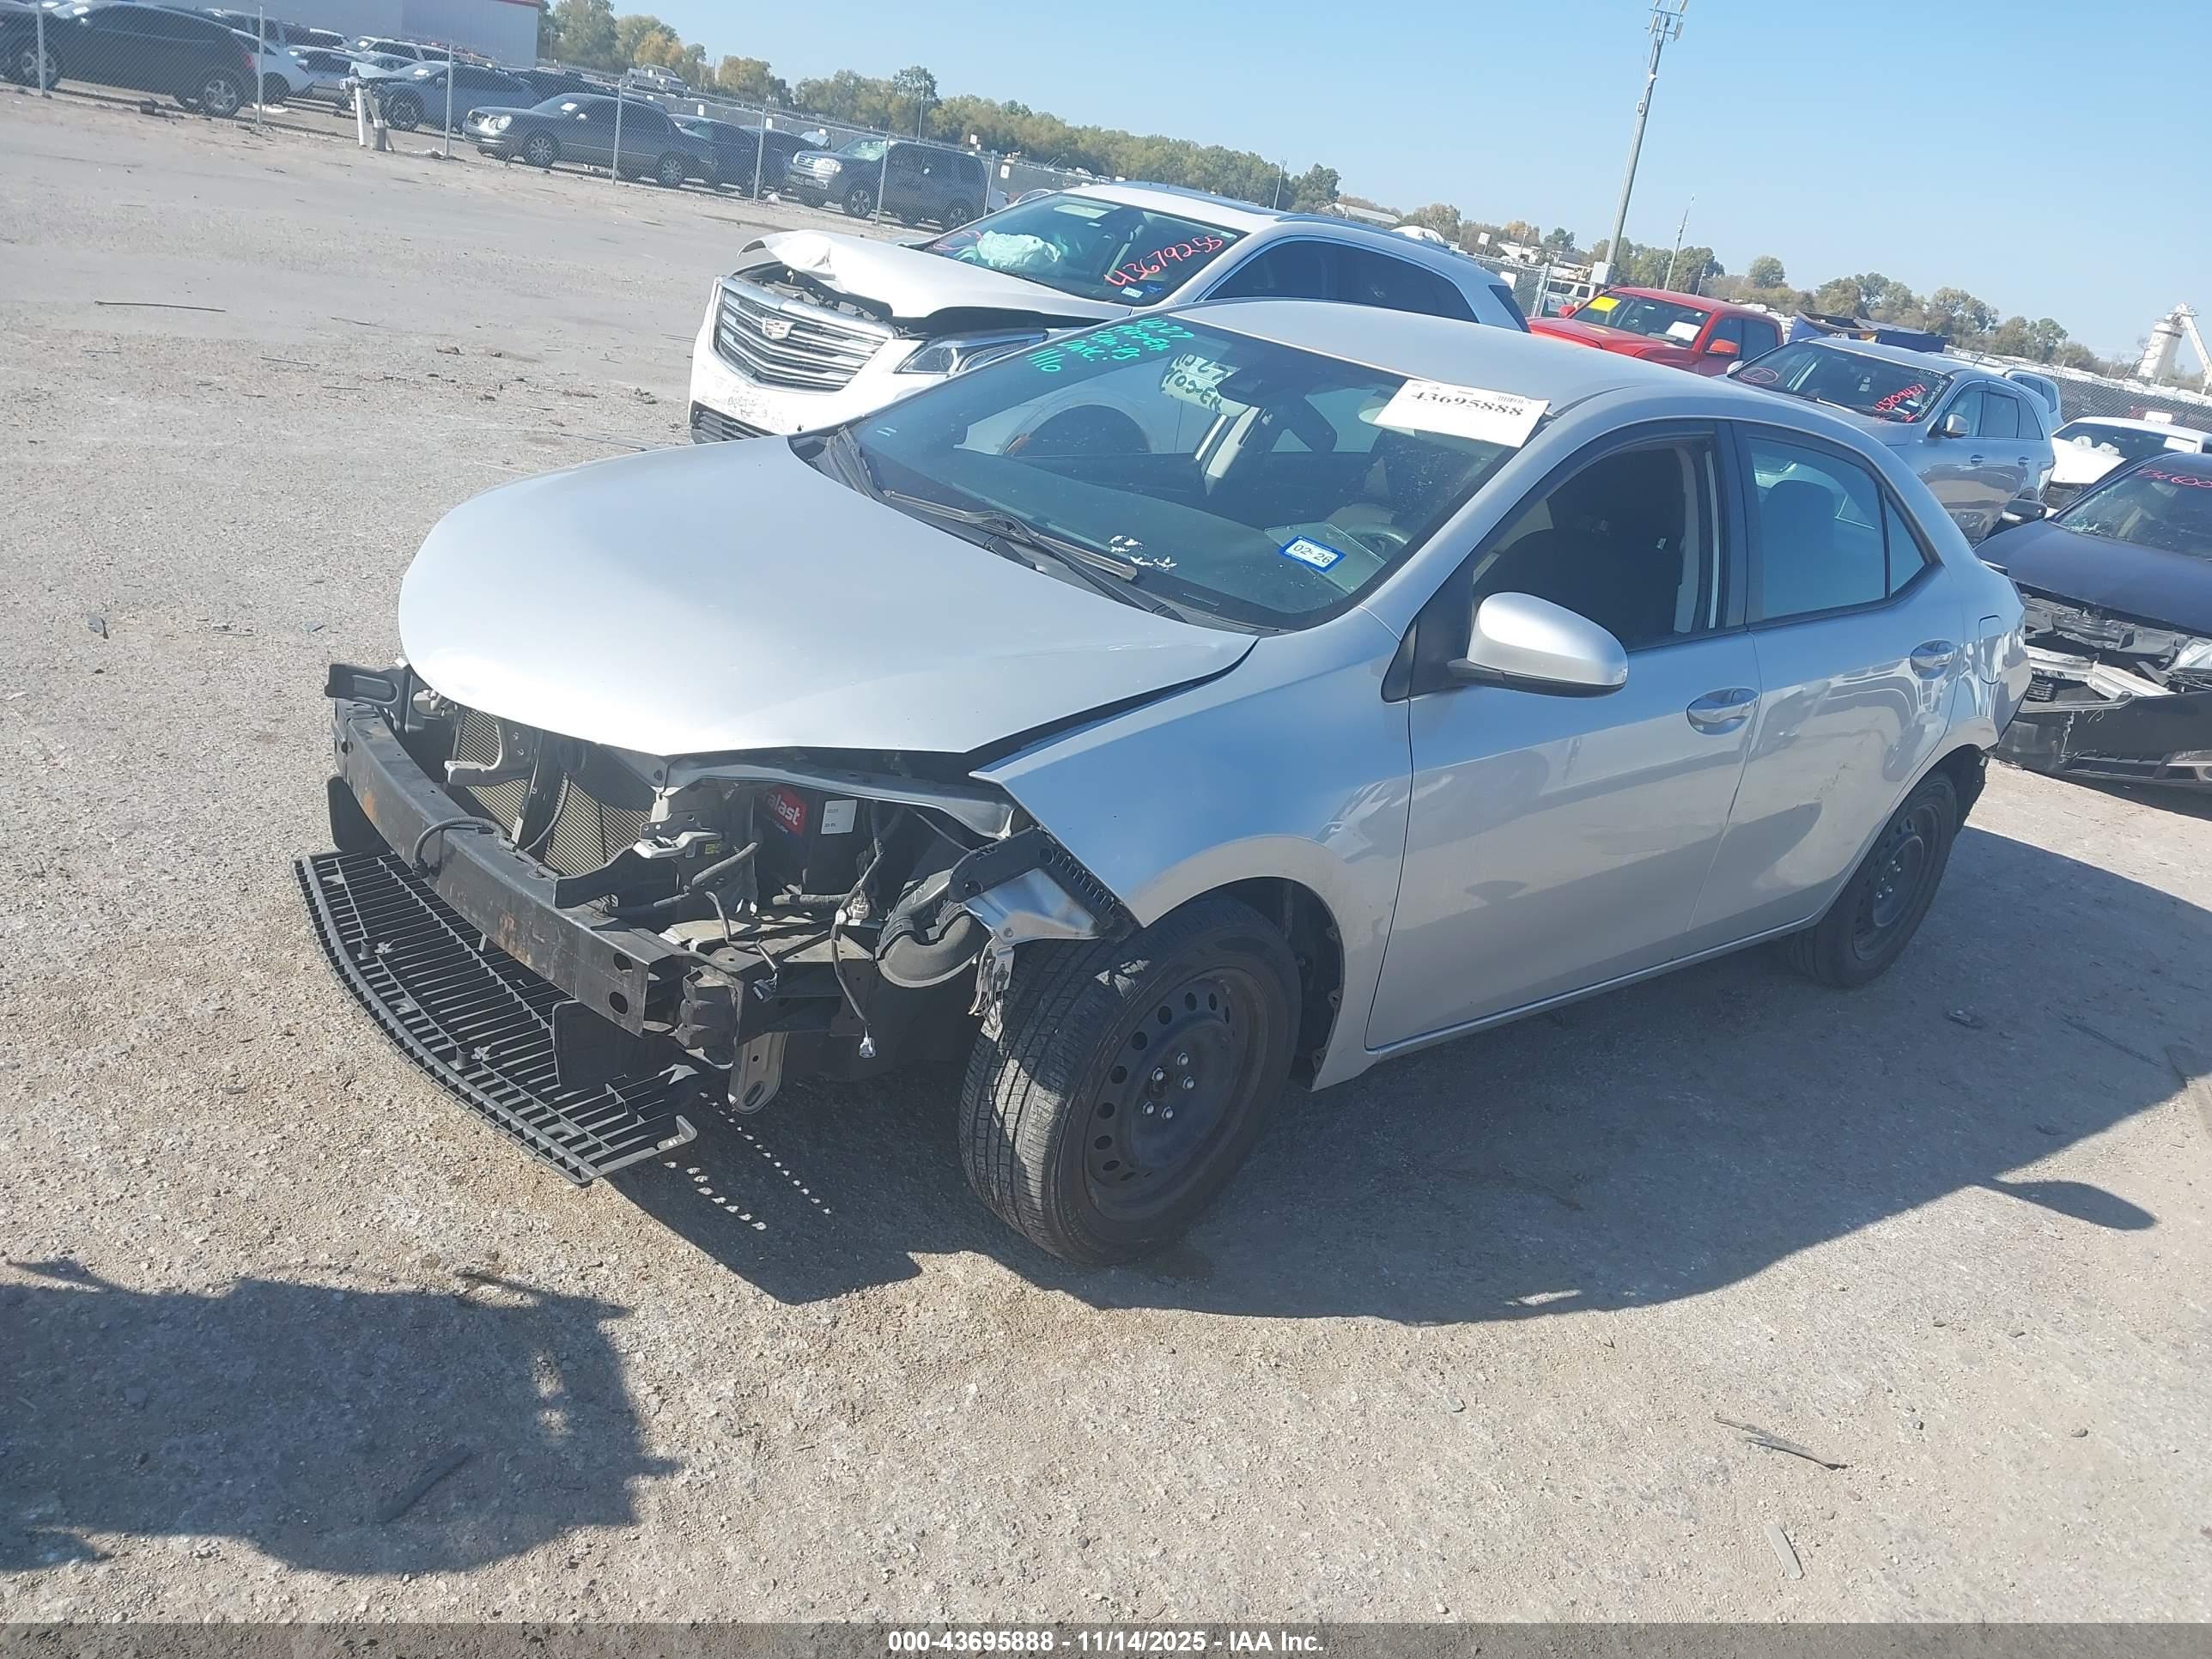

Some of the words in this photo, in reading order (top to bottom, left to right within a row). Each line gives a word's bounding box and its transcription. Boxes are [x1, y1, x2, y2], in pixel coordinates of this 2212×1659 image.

[1103, 234, 1223, 286] 43679255
[1411, 392, 1523, 416] 43695888
[1293, 544, 1312, 556] 02
[1313, 552, 1333, 563] 26
